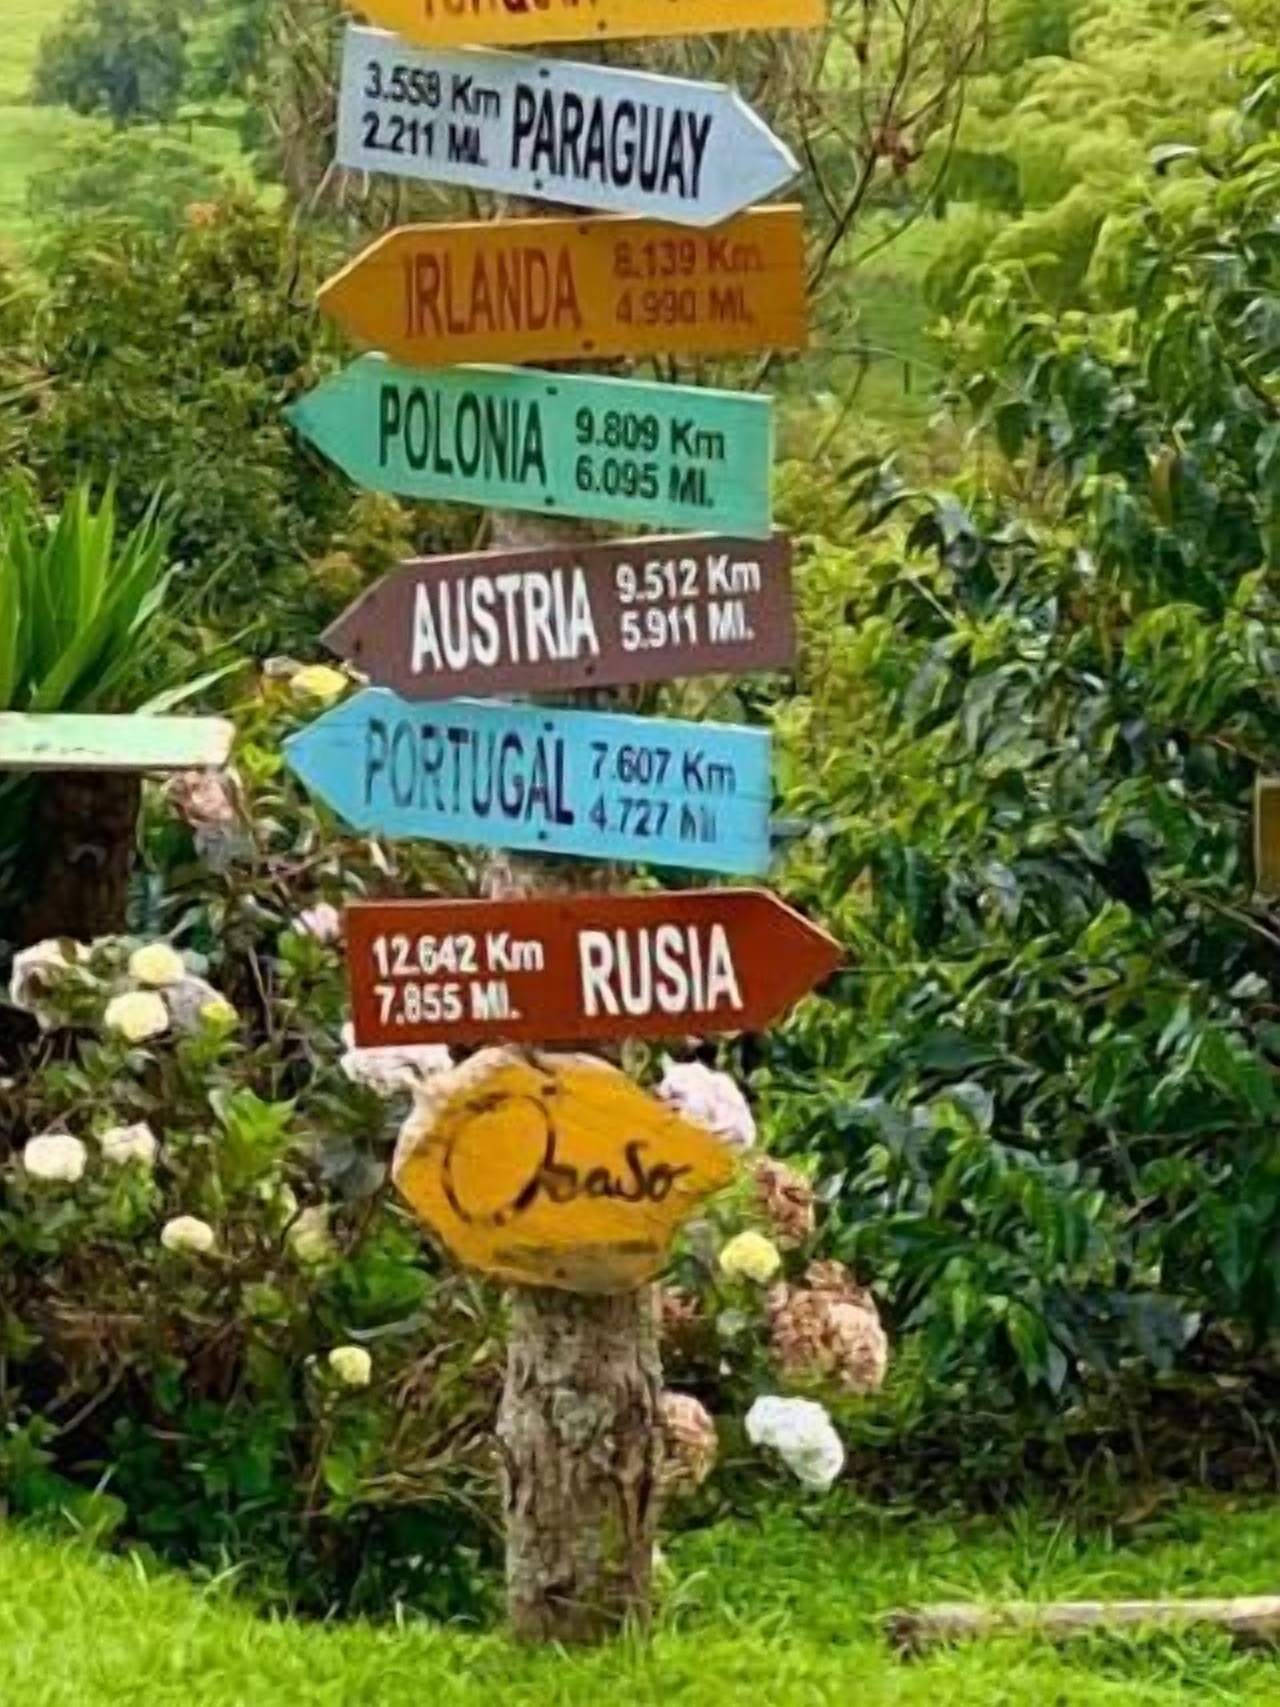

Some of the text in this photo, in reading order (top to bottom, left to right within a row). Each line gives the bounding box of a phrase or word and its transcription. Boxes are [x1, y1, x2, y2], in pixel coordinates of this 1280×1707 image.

[364, 59, 501, 119] 3.558 Km
[362, 110, 436, 159] 2.211
[511, 83, 712, 200] PARAGUAY
[403, 245, 583, 339] IRLANDA
[378, 383, 547, 488] POLONIA
[575, 405, 725, 460] 9.809 Km
[575, 454, 659, 499] 6.095
[616, 553, 761, 603] 9.512 Km
[411, 568, 599, 674] AUSTRIA
[620, 603, 697, 652] 5.911
[363, 717, 575, 827] PORTUGAL
[590, 741, 736, 794] 7.607 Km
[372, 930, 545, 978] 12.642 Km
[578, 923, 744, 1017] RUSIA
[373, 981, 463, 1026] 7.855
